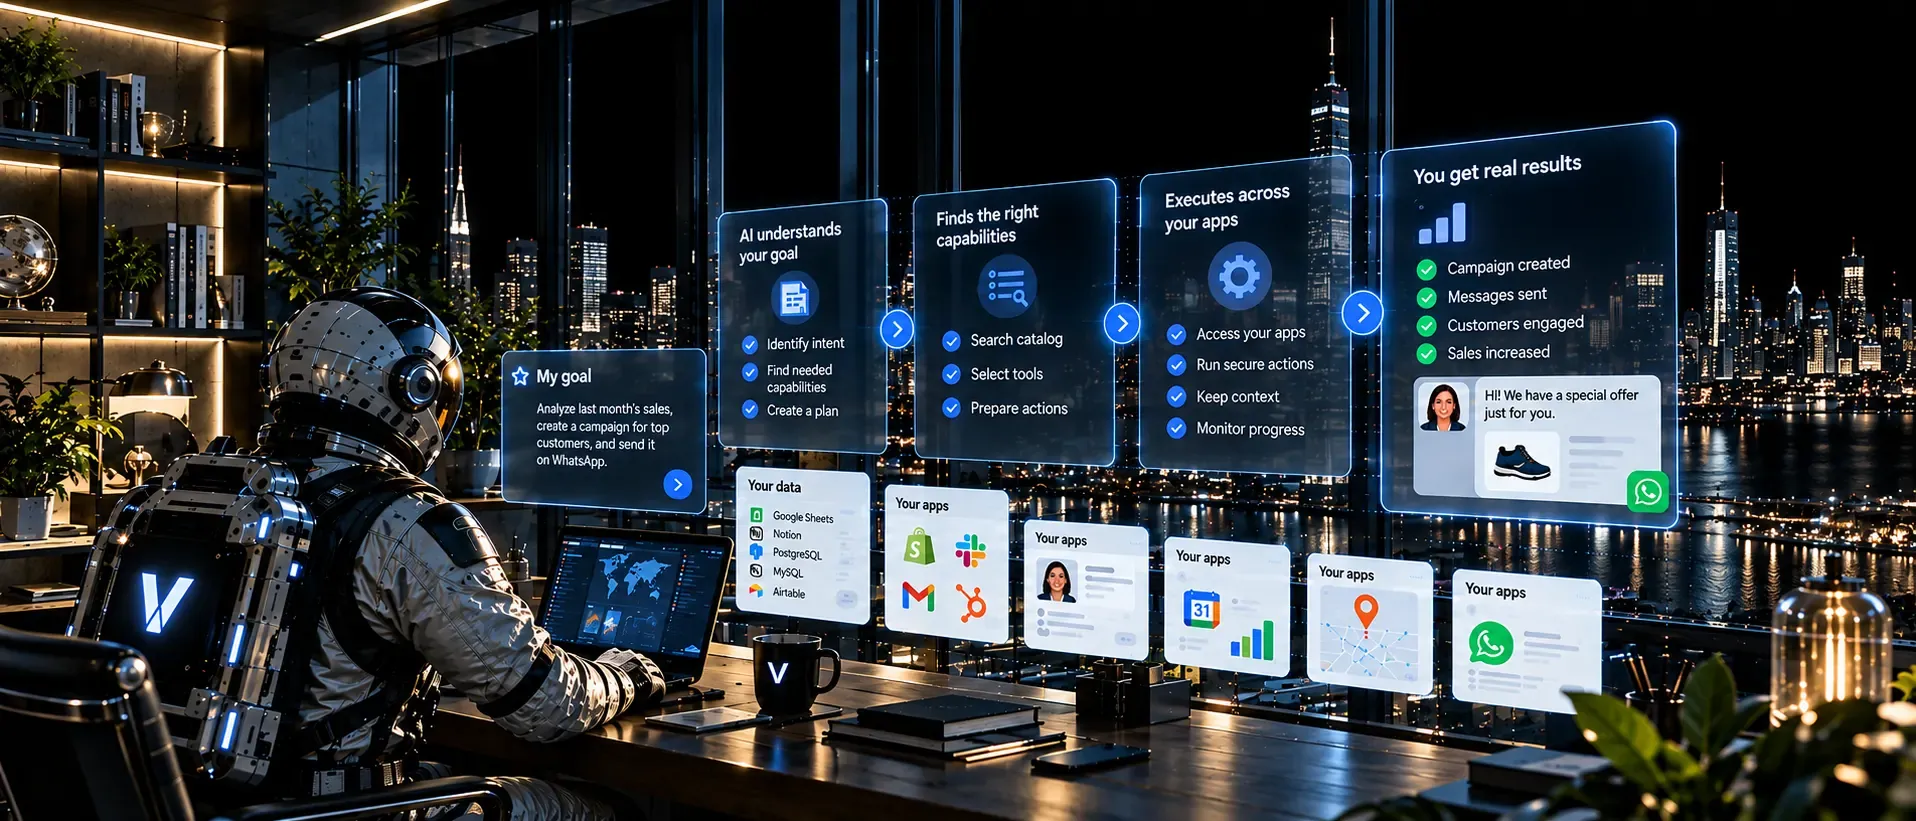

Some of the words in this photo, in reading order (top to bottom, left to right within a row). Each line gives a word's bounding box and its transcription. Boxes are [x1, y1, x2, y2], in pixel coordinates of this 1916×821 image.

[1413, 168, 1445, 185] You
[1449, 164, 1480, 187] get
[1484, 158, 1517, 179] real
[1522, 154, 1582, 176] results
[1165, 190, 1235, 209] Executes
[1238, 186, 1291, 203] across
[936, 208, 974, 227] Finds
[976, 207, 1001, 223] the
[1004, 203, 1040, 224] right
[739, 227, 754, 243] AI
[757, 220, 842, 242] understands
[1164, 217, 1199, 236] your
[1201, 214, 1239, 233] apps
[936, 227, 1017, 251] capabilities
[739, 250, 769, 267] your
[770, 244, 798, 265] goal
[1447, 259, 1515, 277] Campaign
[1517, 254, 1571, 272] created
[1448, 289, 1515, 306] Messages
[1517, 287, 1548, 301] sent
[1447, 318, 1520, 332] Customers
[1523, 314, 1585, 333] engaged
[970, 332, 1014, 347] Search
[1016, 331, 1063, 349] catalog
[1196, 327, 1241, 341] Access
[1243, 328, 1272, 343] your
[1274, 328, 1306, 342] apps
[767, 336, 810, 353] Identify
[812, 336, 845, 349] intent
[1447, 345, 1482, 360] Sales
[1485, 343, 1550, 359] increased
[767, 364, 790, 376] Find
[792, 363, 833, 376] needed
[1197, 357, 1221, 371] Run
[1223, 360, 1265, 371] secure
[1267, 356, 1315, 371] actions
[536, 368, 559, 388] My
[561, 367, 592, 387] goal
[971, 367, 1010, 381] Select
[1012, 366, 1044, 381] tools
[767, 380, 827, 396] capabilities
[1503, 389, 1523, 402] We
[1525, 388, 1554, 401] have
[1555, 391, 1563, 401] a
[1565, 388, 1607, 404] special
[1609, 388, 1639, 401] offer
[1197, 389, 1229, 407] Keep
[1231, 390, 1280, 403] context
[536, 402, 576, 417] Analyze
[578, 402, 597, 415] last
[643, 402, 673, 417] sales,
[767, 403, 803, 417] Create
[805, 407, 812, 417] a
[814, 403, 839, 420] plan
[971, 401, 1020, 418] Prepare
[1021, 401, 1069, 415] actions
[1483, 406, 1507, 422] just
[1508, 406, 1527, 419] for
[1529, 409, 1556, 422] you.
[536, 420, 569, 432] create
[570, 422, 577, 432] a
[578, 420, 630, 436] campaign
[632, 420, 649, 433] for
[650, 422, 670, 436] top
[1197, 421, 1246, 435] Monitor
[1249, 425, 1305, 439] progress
[536, 437, 593, 451] customers,
[595, 437, 616, 450] and
[618, 438, 645, 451] send
[647, 438, 656, 451] it
[536, 456, 550, 466] on
[551, 454, 608, 470] WhatsApp.
[747, 478, 774, 492] Your
[775, 479, 802, 494] data
[895, 496, 921, 510] Your
[922, 501, 950, 514] apps
[773, 510, 804, 524] Google
[804, 512, 834, 524] Sheets
[773, 528, 802, 540] Notion
[1035, 531, 1060, 544] Your
[1061, 536, 1088, 549] apps
[773, 546, 823, 562] PostgreSQL
[909, 541, 920, 558] S
[1175, 549, 1202, 563] Your
[1203, 554, 1231, 568] apps
[773, 566, 804, 580] MySQL
[1318, 565, 1345, 579] Your
[1346, 570, 1375, 584] apps
[772, 586, 806, 600] Airtable
[1465, 581, 1494, 596] Your
[1495, 587, 1527, 601] apps
[141, 572, 195, 634] V
[1194, 603, 1209, 618] 31
[767, 661, 789, 684] V
